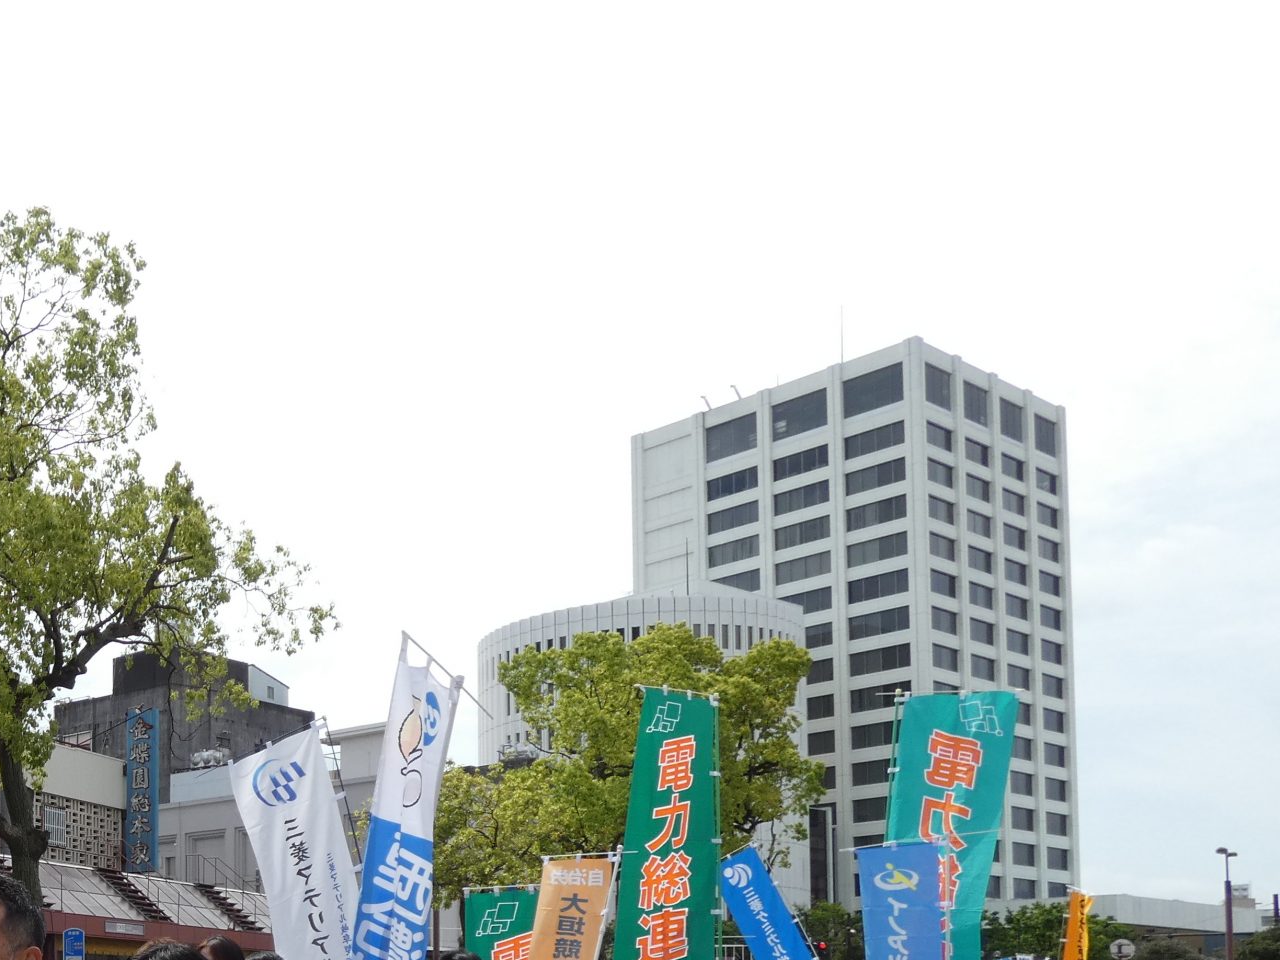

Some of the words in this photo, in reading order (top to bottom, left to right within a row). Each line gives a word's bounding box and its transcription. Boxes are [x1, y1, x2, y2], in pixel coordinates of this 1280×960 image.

[127, 716, 155, 866] 金蝶園総本家
